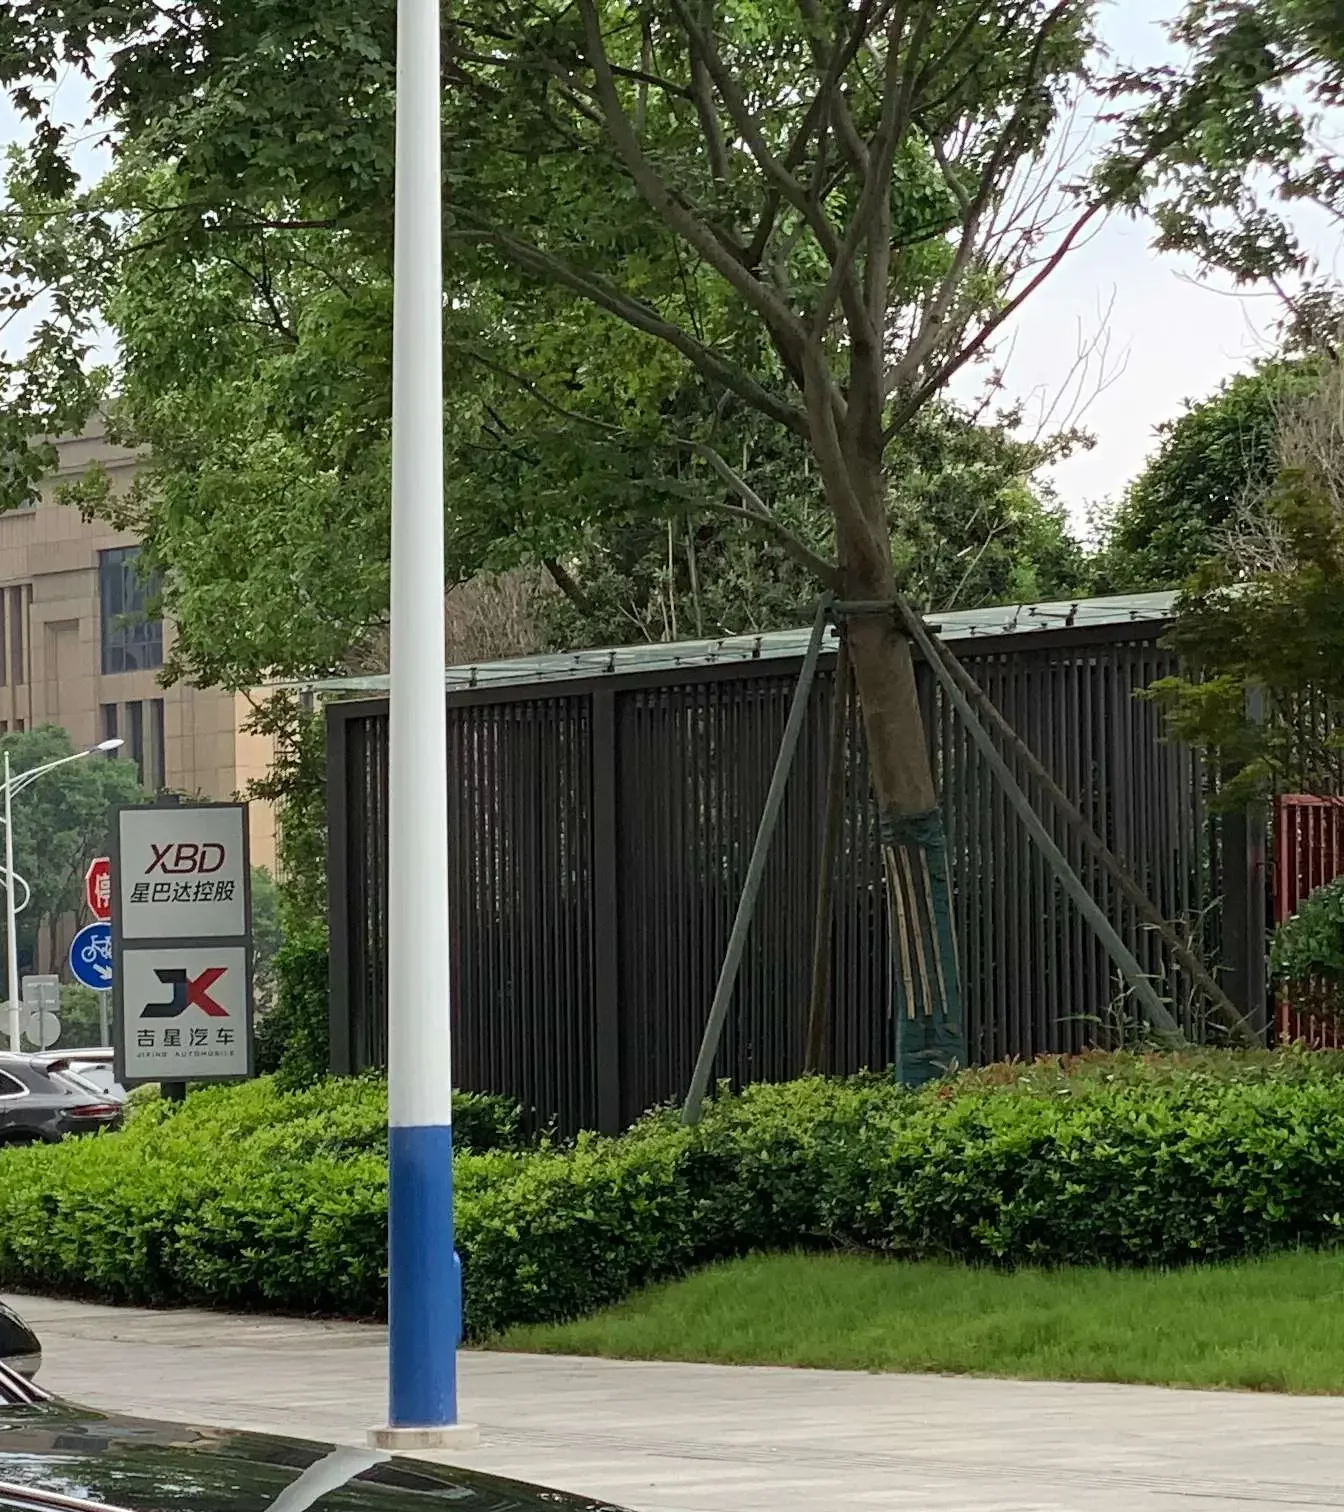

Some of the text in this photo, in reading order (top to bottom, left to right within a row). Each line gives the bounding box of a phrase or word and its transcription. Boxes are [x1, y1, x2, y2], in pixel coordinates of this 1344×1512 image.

[144, 843, 226, 875] XBD
[130, 880, 235, 904] 星巴达控股
[137, 1027, 236, 1047] 吉星汽车
